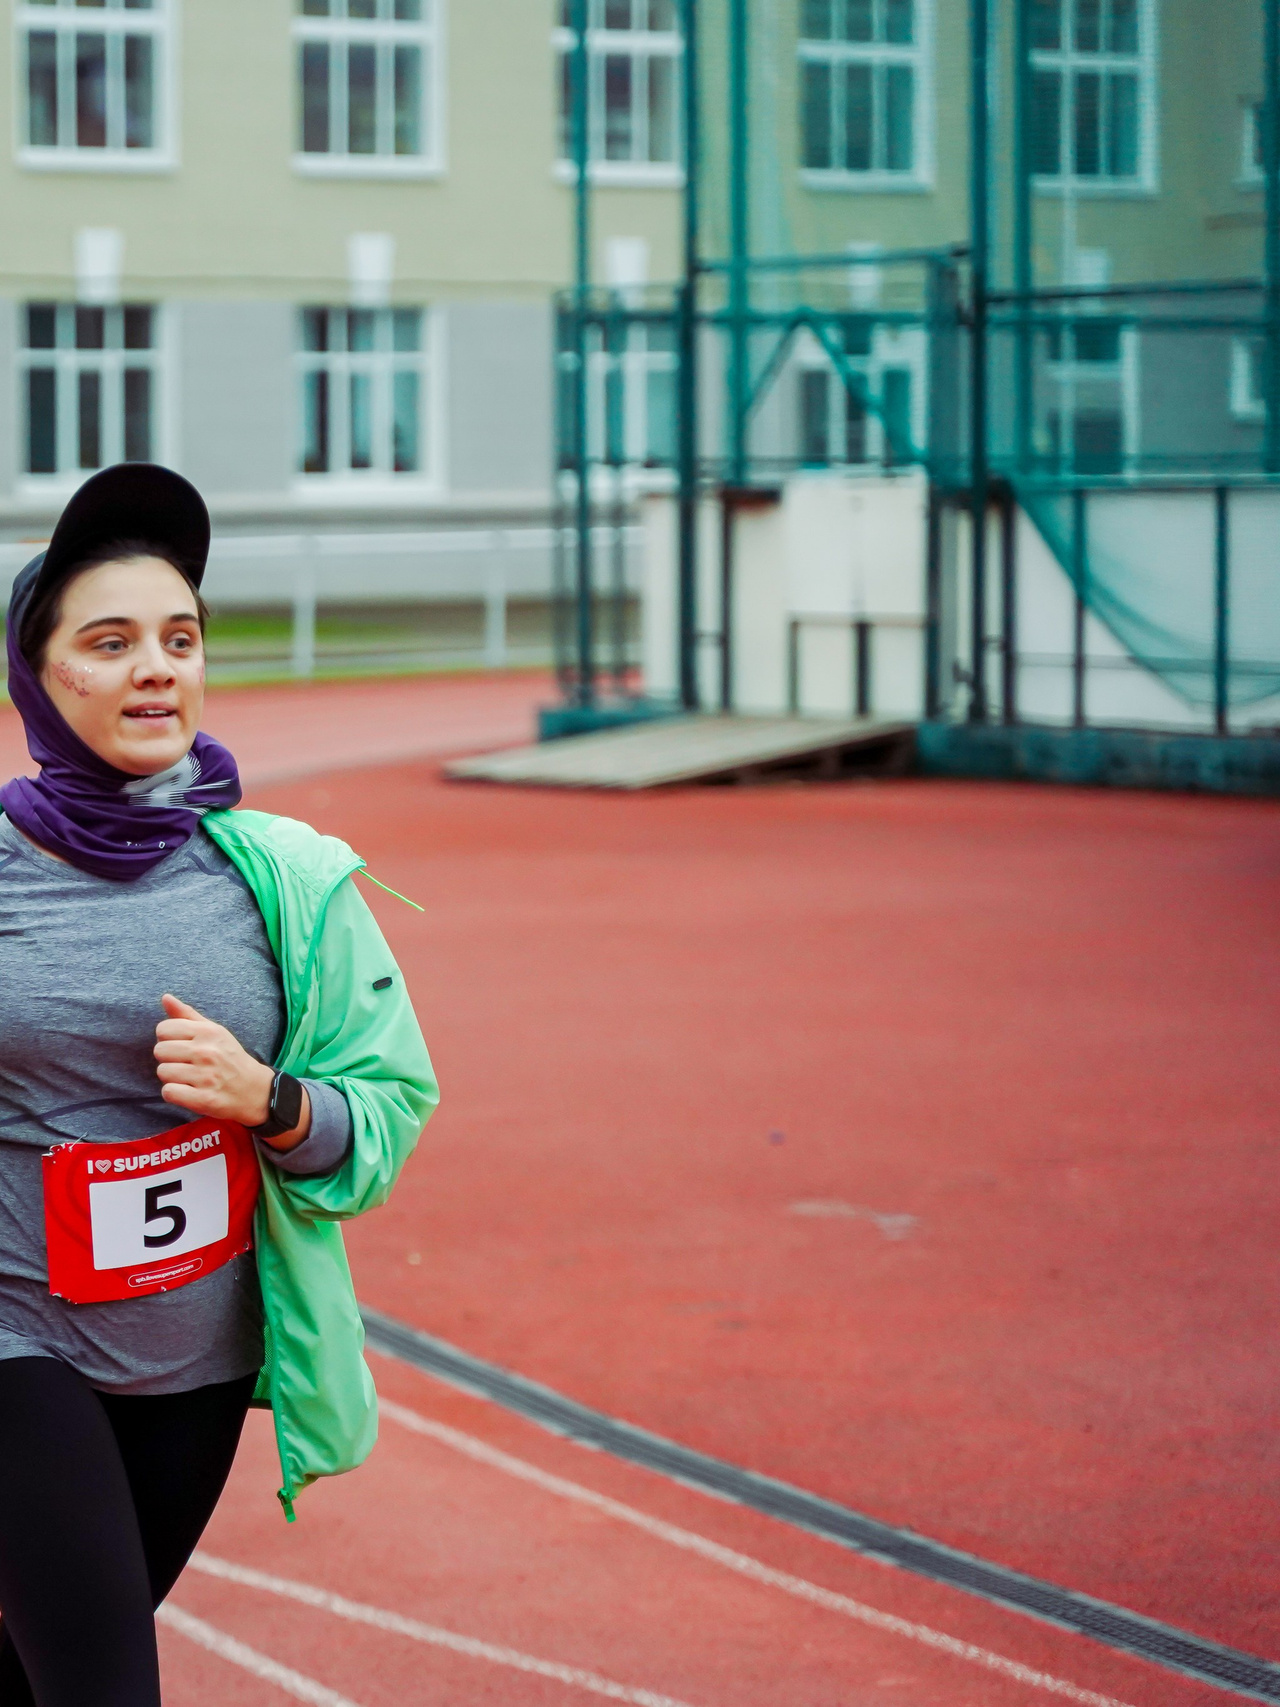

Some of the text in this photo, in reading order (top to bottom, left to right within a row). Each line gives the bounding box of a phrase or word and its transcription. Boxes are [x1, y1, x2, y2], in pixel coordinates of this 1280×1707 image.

[87, 1130, 221, 1174] I SUPERSPORT
[143, 1179, 187, 1249] 5
